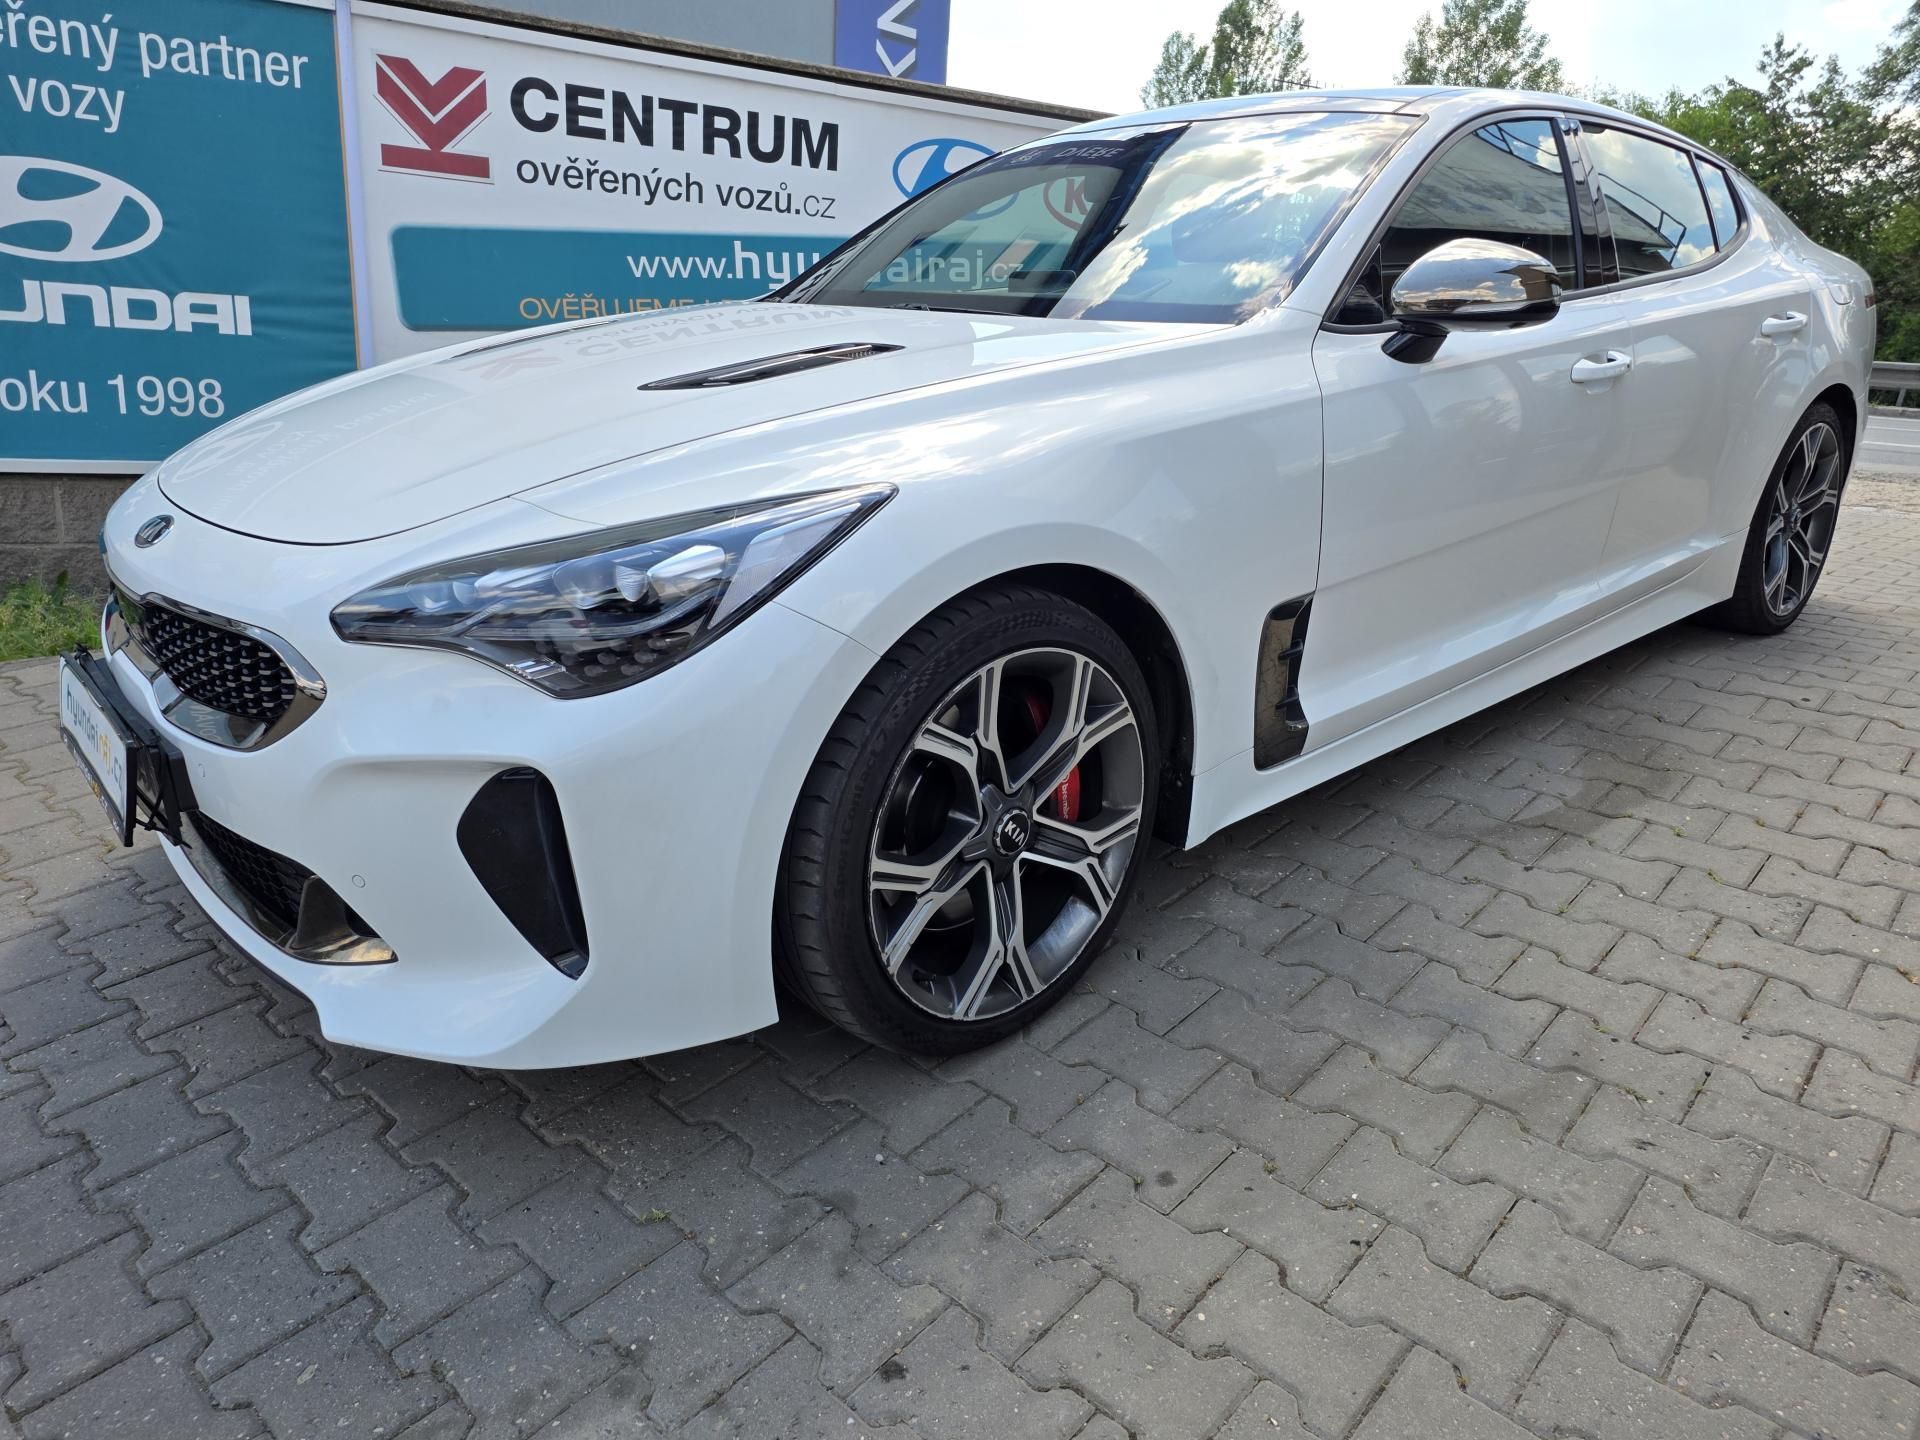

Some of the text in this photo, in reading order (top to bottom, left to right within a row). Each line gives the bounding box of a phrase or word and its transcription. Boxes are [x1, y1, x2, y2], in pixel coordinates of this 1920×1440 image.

[0, 0, 309, 89] řený partner
[9, 75, 125, 133] vozy
[510, 77, 839, 171] CENTRUM
[516, 158, 703, 206] ověřených
[0, 369, 225, 418] oku 1998
[1004, 820, 1025, 846] KIA
